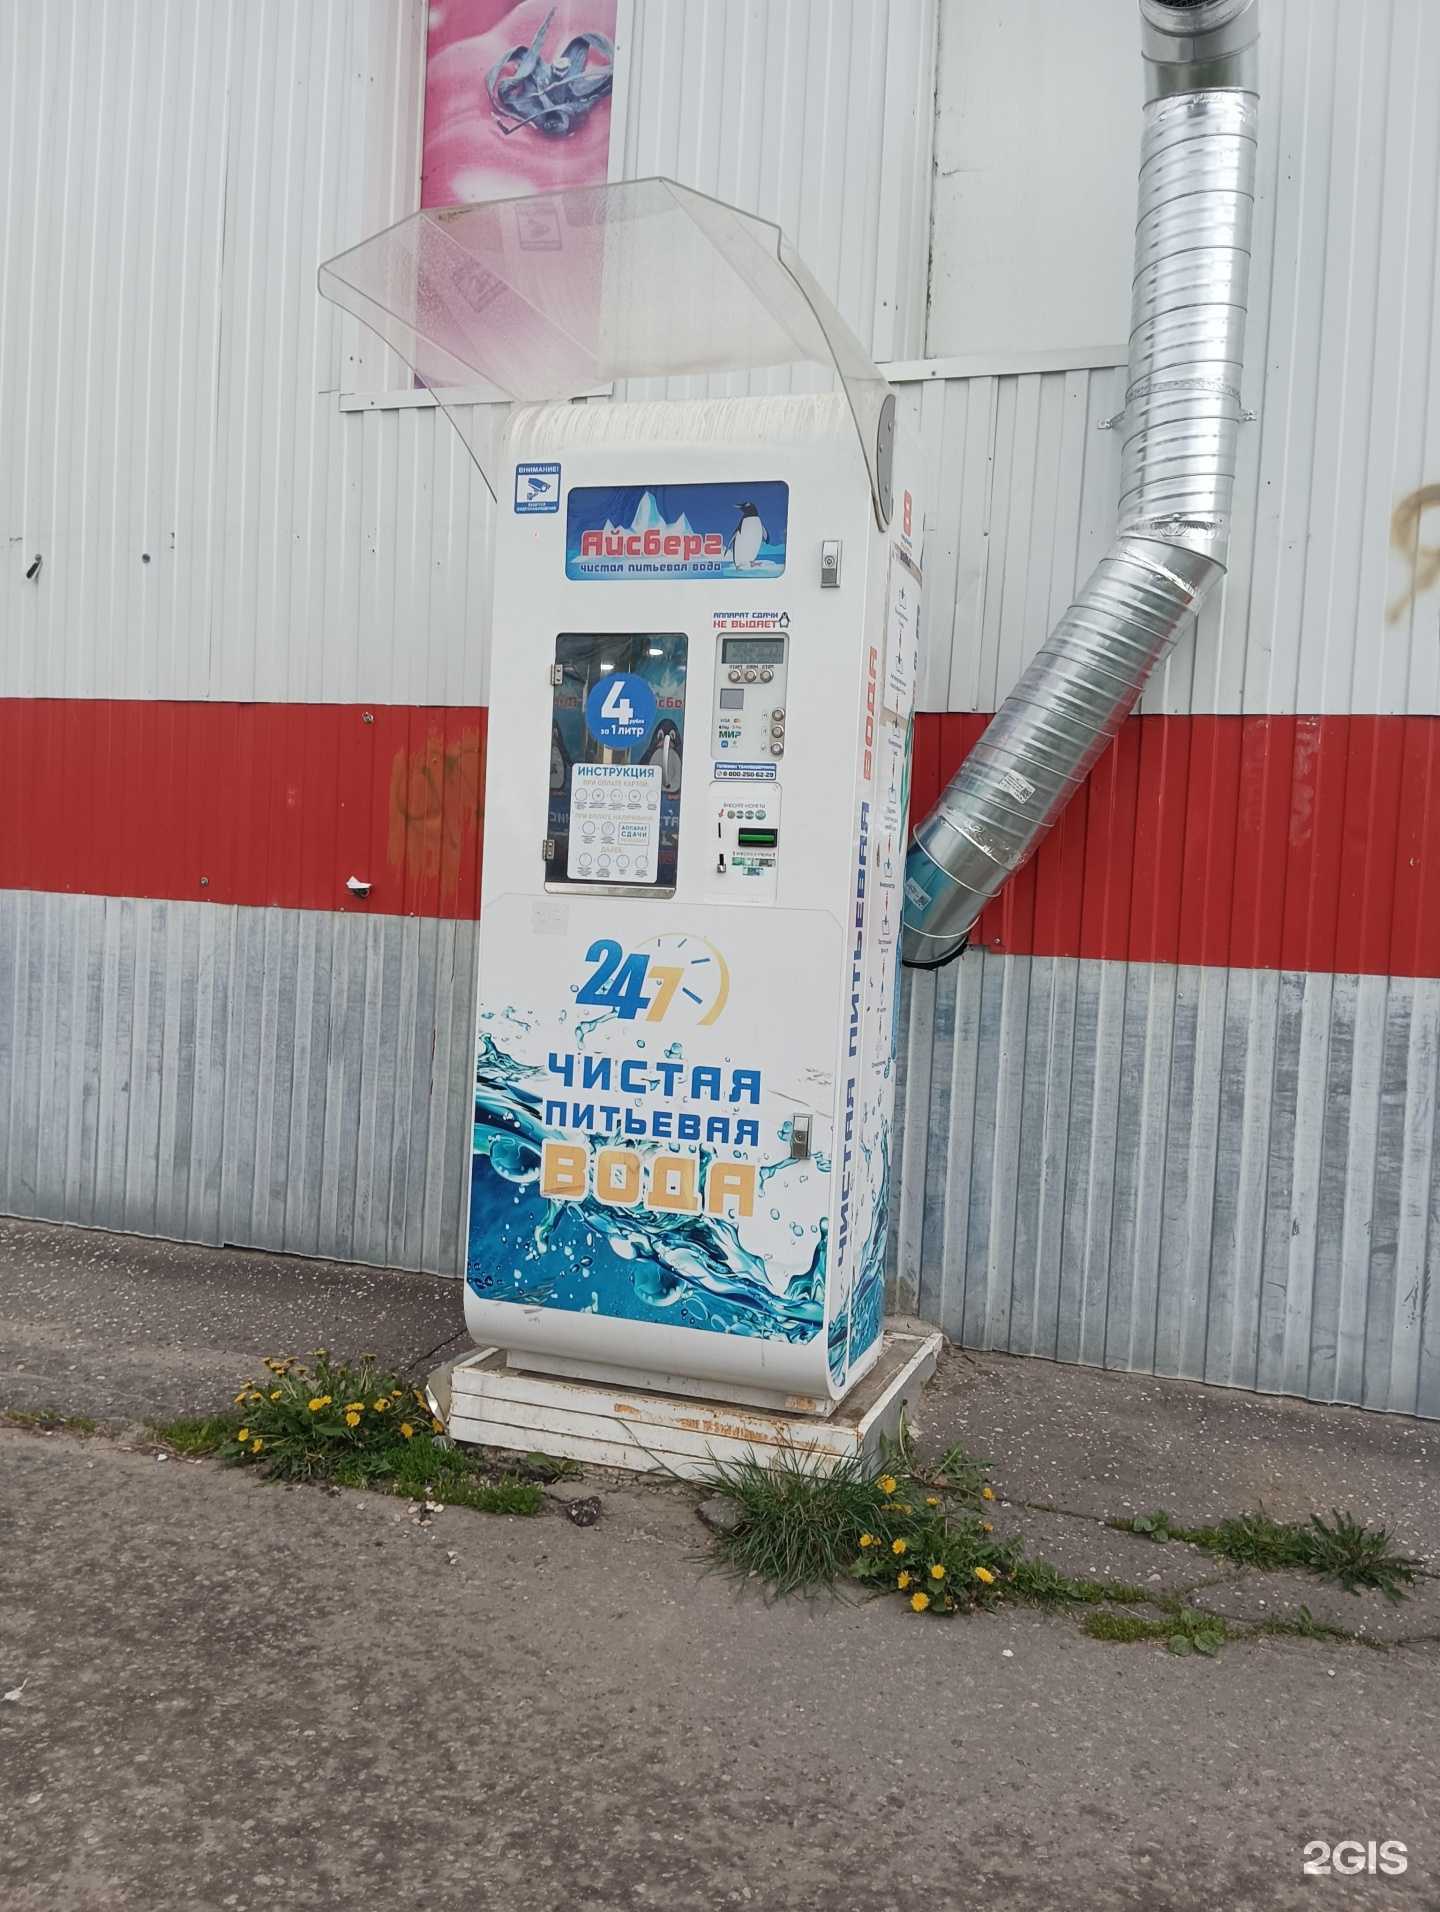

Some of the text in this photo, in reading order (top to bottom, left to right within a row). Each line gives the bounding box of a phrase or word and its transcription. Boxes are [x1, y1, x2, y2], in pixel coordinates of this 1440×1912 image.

[582, 529, 722, 560] Айсберг
[580, 563, 721, 573] чистая питьевая вода
[713, 620, 776, 628] НЕ ВЫДАЕТ
[601, 681, 633, 725] 4
[611, 725, 616, 735] 1
[617, 727, 644, 737] литр
[578, 766, 655, 778] ИНСТРУКЦИЯ
[838, 646, 877, 1268] ЧИСТАЯ ПИТЬЕВАЯ ВОДА
[548, 1052, 762, 1105] ЧИСТАЯ
[545, 1099, 760, 1147] ПИТЬЕВАЯ
[543, 1143, 757, 1218] ВОДА
